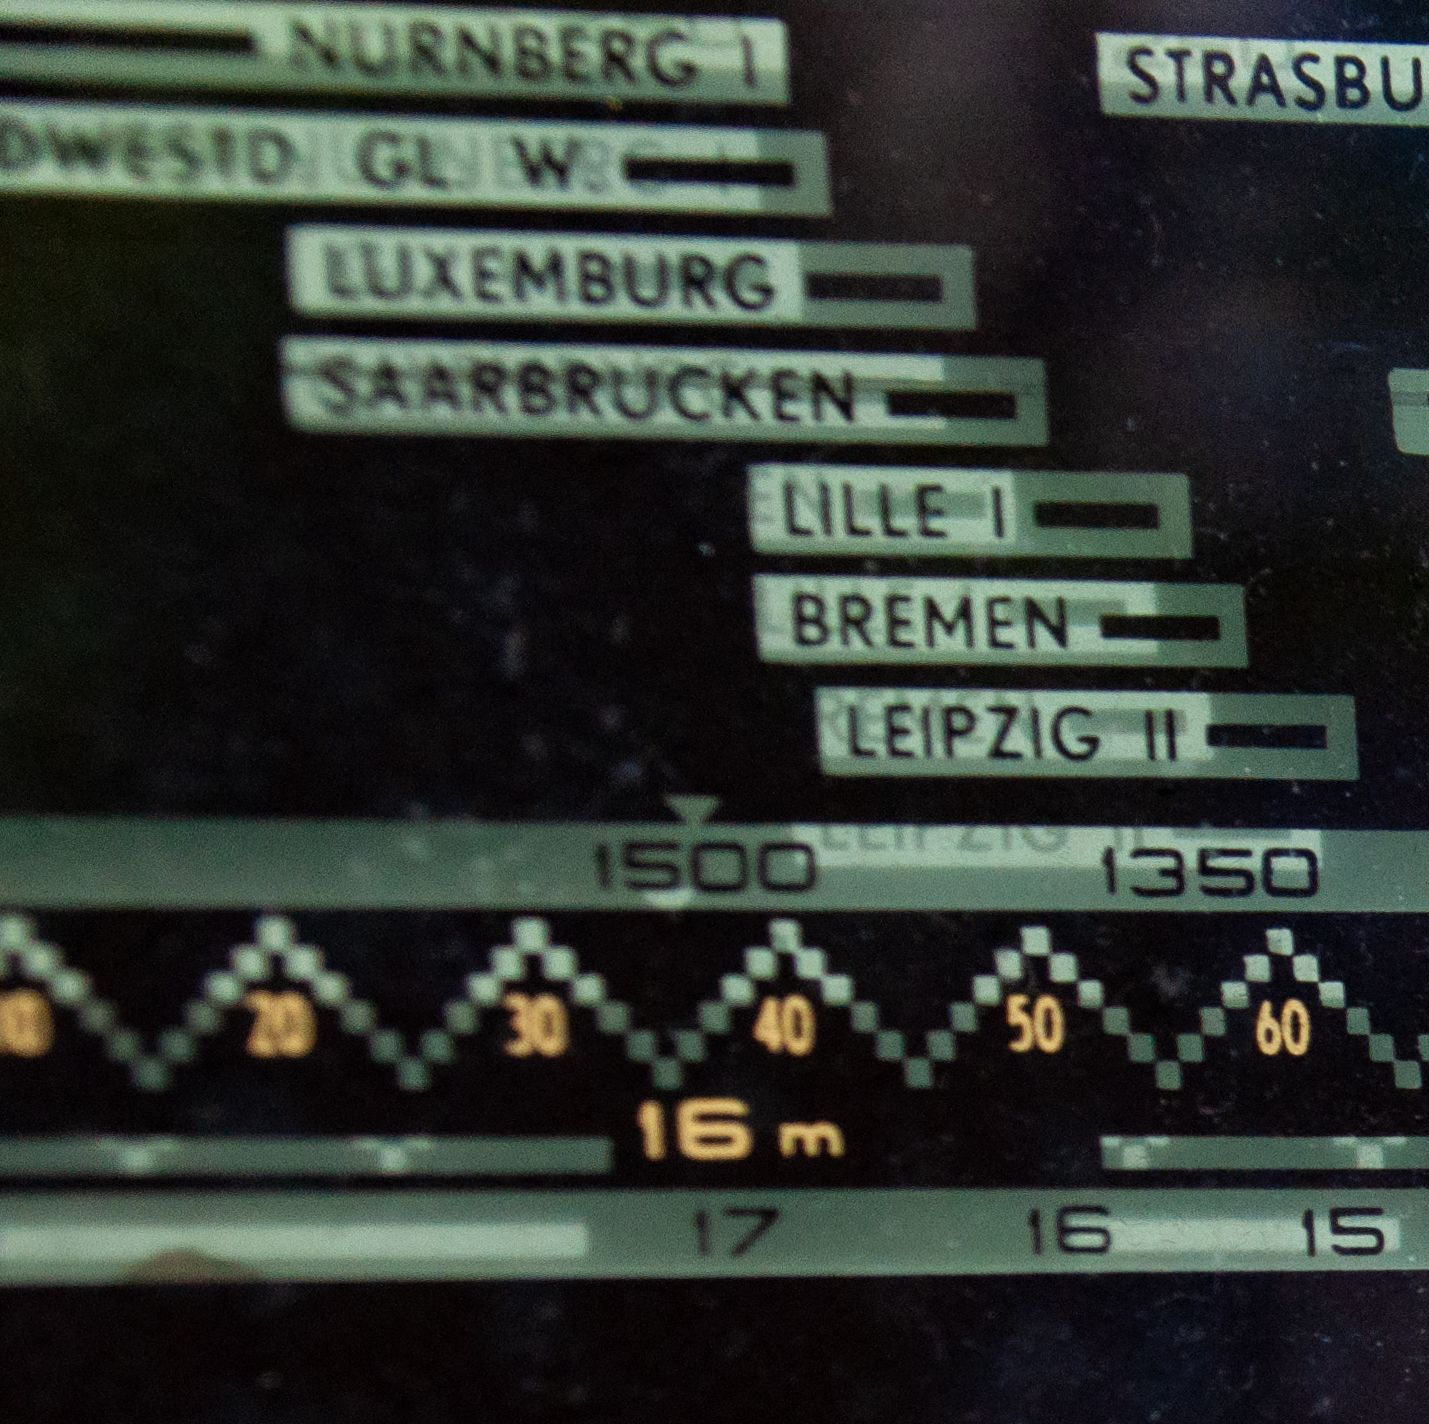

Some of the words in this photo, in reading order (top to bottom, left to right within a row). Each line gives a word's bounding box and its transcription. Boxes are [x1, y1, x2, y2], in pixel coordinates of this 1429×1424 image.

[320, 242, 776, 311] LUXEMBURG
[781, 483, 945, 538] LILLE
[791, 591, 1070, 650] BREMEN
[846, 705, 1101, 761] LEIPZIG
[1143, 708, 1178, 762] II
[598, 841, 817, 893] 1500
[1100, 847, 1319, 899] 1350
[503, 992, 570, 1057] 30
[754, 995, 817, 1056] 40
[1007, 994, 1064, 1054] 50
[1256, 999, 1311, 1055] 60
[636, 1100, 753, 1161] 16
[778, 1119, 845, 1158] m
[696, 1208, 780, 1259] 17
[1029, 1206, 1113, 1257] 16
[1301, 1207, 1386, 1257] 15
